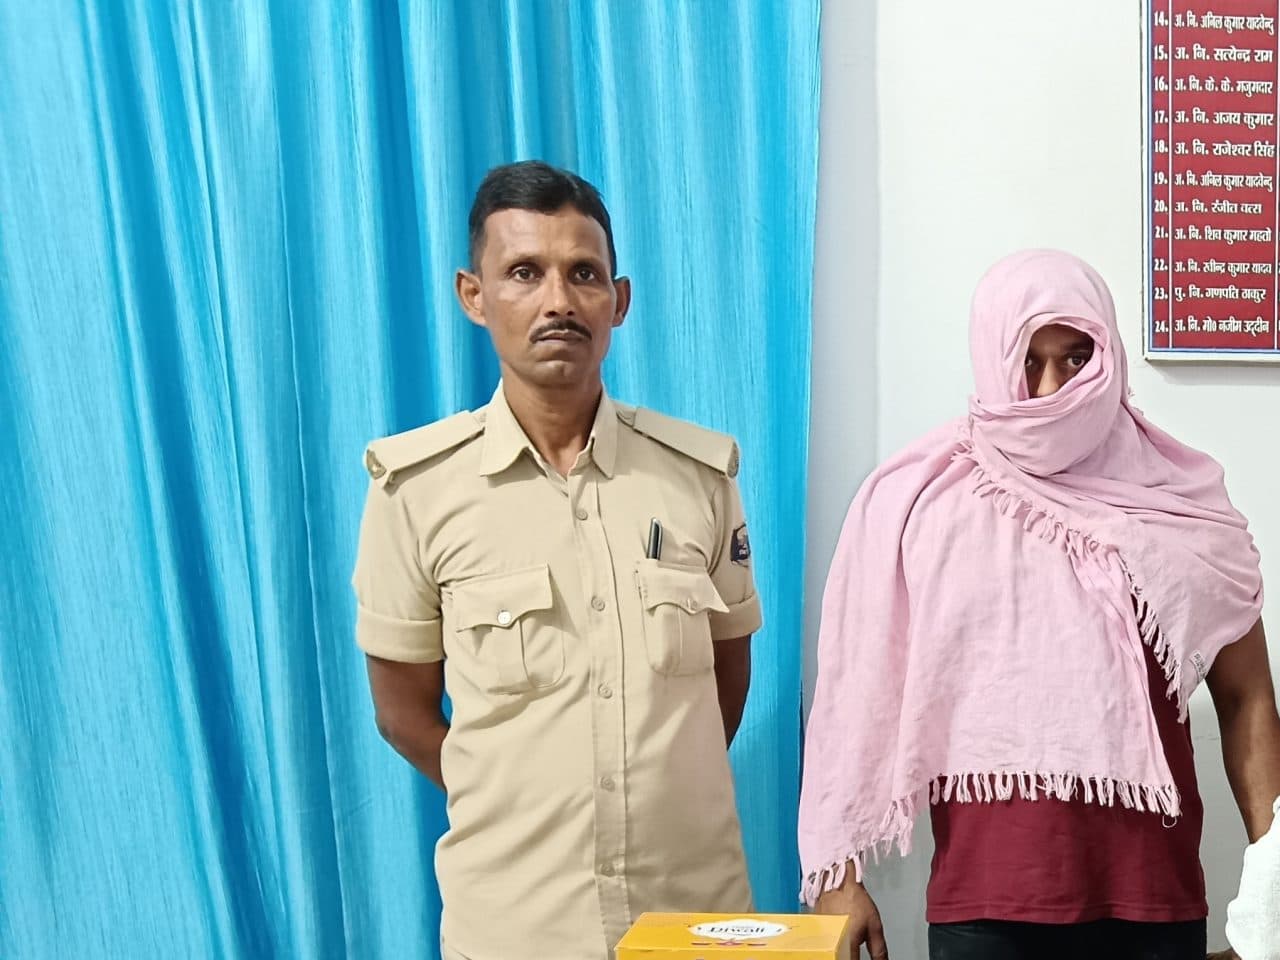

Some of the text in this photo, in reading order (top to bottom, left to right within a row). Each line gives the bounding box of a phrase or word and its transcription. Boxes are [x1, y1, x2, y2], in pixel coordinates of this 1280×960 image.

[1154, 11, 1168, 26] 14.
[1175, 14, 1185, 27] अ.
[1200, 11, 1222, 29] अनिल
[1224, 15, 1244, 34] कुमार
[1154, 45, 1168, 60] 15.
[1175, 46, 1189, 61] अ.
[1193, 43, 1209, 61] नि.
[1254, 49, 1273, 63] राम
[1154, 76, 1168, 91] 16.
[1175, 78, 1186, 91] अ.
[1205, 76, 1218, 92] के.
[1221, 76, 1234, 92] के.
[1236, 80, 1273, 97] मजुमदार
[1154, 110, 1168, 124] 17.
[1175, 111, 1189, 124] अ.
[1192, 107, 1209, 124] नि.
[1213, 112, 1240, 125] अजय
[1244, 112, 1274, 129] कुमार
[1154, 140, 1168, 153] 18.
[1175, 142, 1188, 154] अ.
[1192, 139, 1209, 155] नि.
[1213, 140, 1251, 156] राजेश्वर
[1254, 141, 1275, 157] सिंह
[1154, 172, 1168, 184] 19.
[1175, 173, 1185, 186] अ.
[1200, 171, 1221, 187] अनिल
[1223, 175, 1243, 191] कुमार
[1154, 200, 1168, 213] 20.
[1175, 201, 1188, 213] अ.
[1192, 199, 1208, 213] नि.
[1212, 200, 1238, 214] रंजीत
[1155, 226, 1168, 238] 21.
[1175, 228, 1186, 240] अ.
[1205, 225, 1221, 241] शिव
[1224, 230, 1247, 245] कुमार
[1250, 227, 1272, 242] महतो
[1154, 259, 1168, 272] 22.
[1175, 261, 1186, 272] अ.
[1228, 262, 1250, 277] कुमार
[1252, 262, 1272, 274] यादव
[1154, 288, 1168, 300] 23.
[1175, 288, 1185, 303] पु.
[1206, 285, 1239, 300] गणपति
[1242, 288, 1267, 304] ठाकुर
[1155, 321, 1169, 333] 24.
[1175, 319, 1186, 332] अ.
[1218, 317, 1242, 333] नजीम
